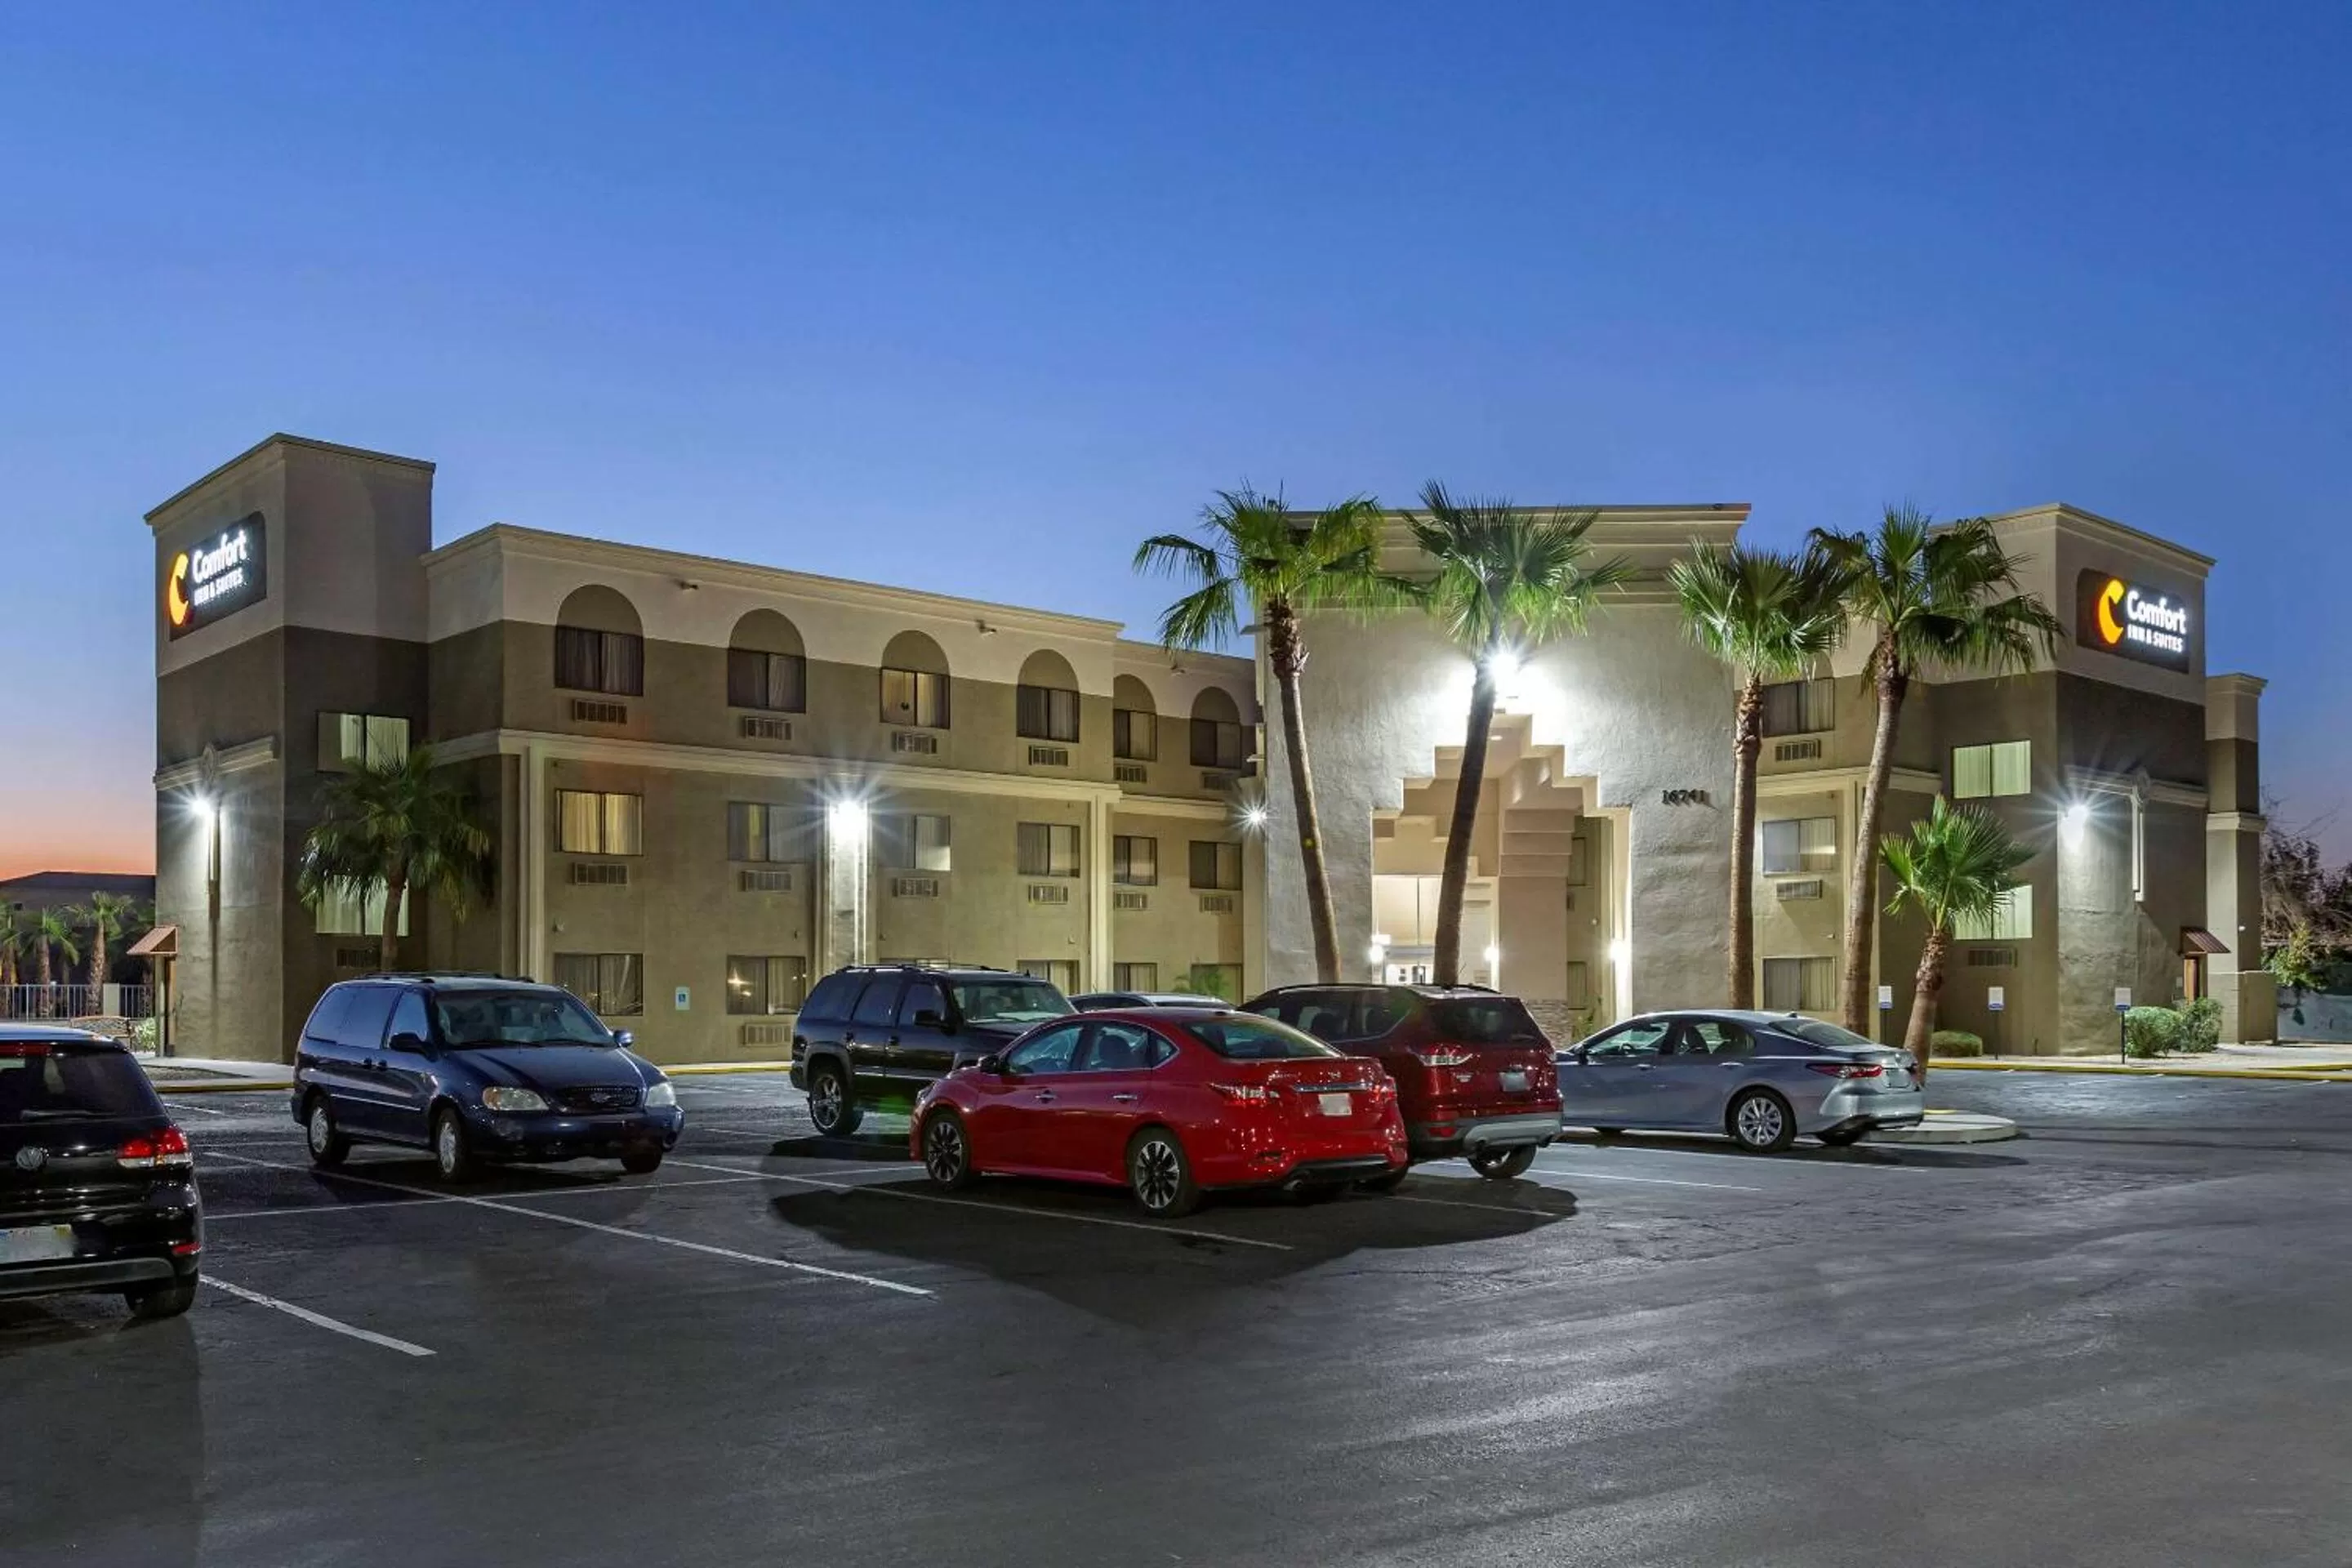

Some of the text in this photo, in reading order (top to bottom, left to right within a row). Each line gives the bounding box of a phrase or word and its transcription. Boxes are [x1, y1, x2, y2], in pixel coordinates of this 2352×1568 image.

[192, 529, 247, 584] Comfort
[2127, 590, 2186, 635] Comfort
[2153, 631, 2183, 653] SUITES
